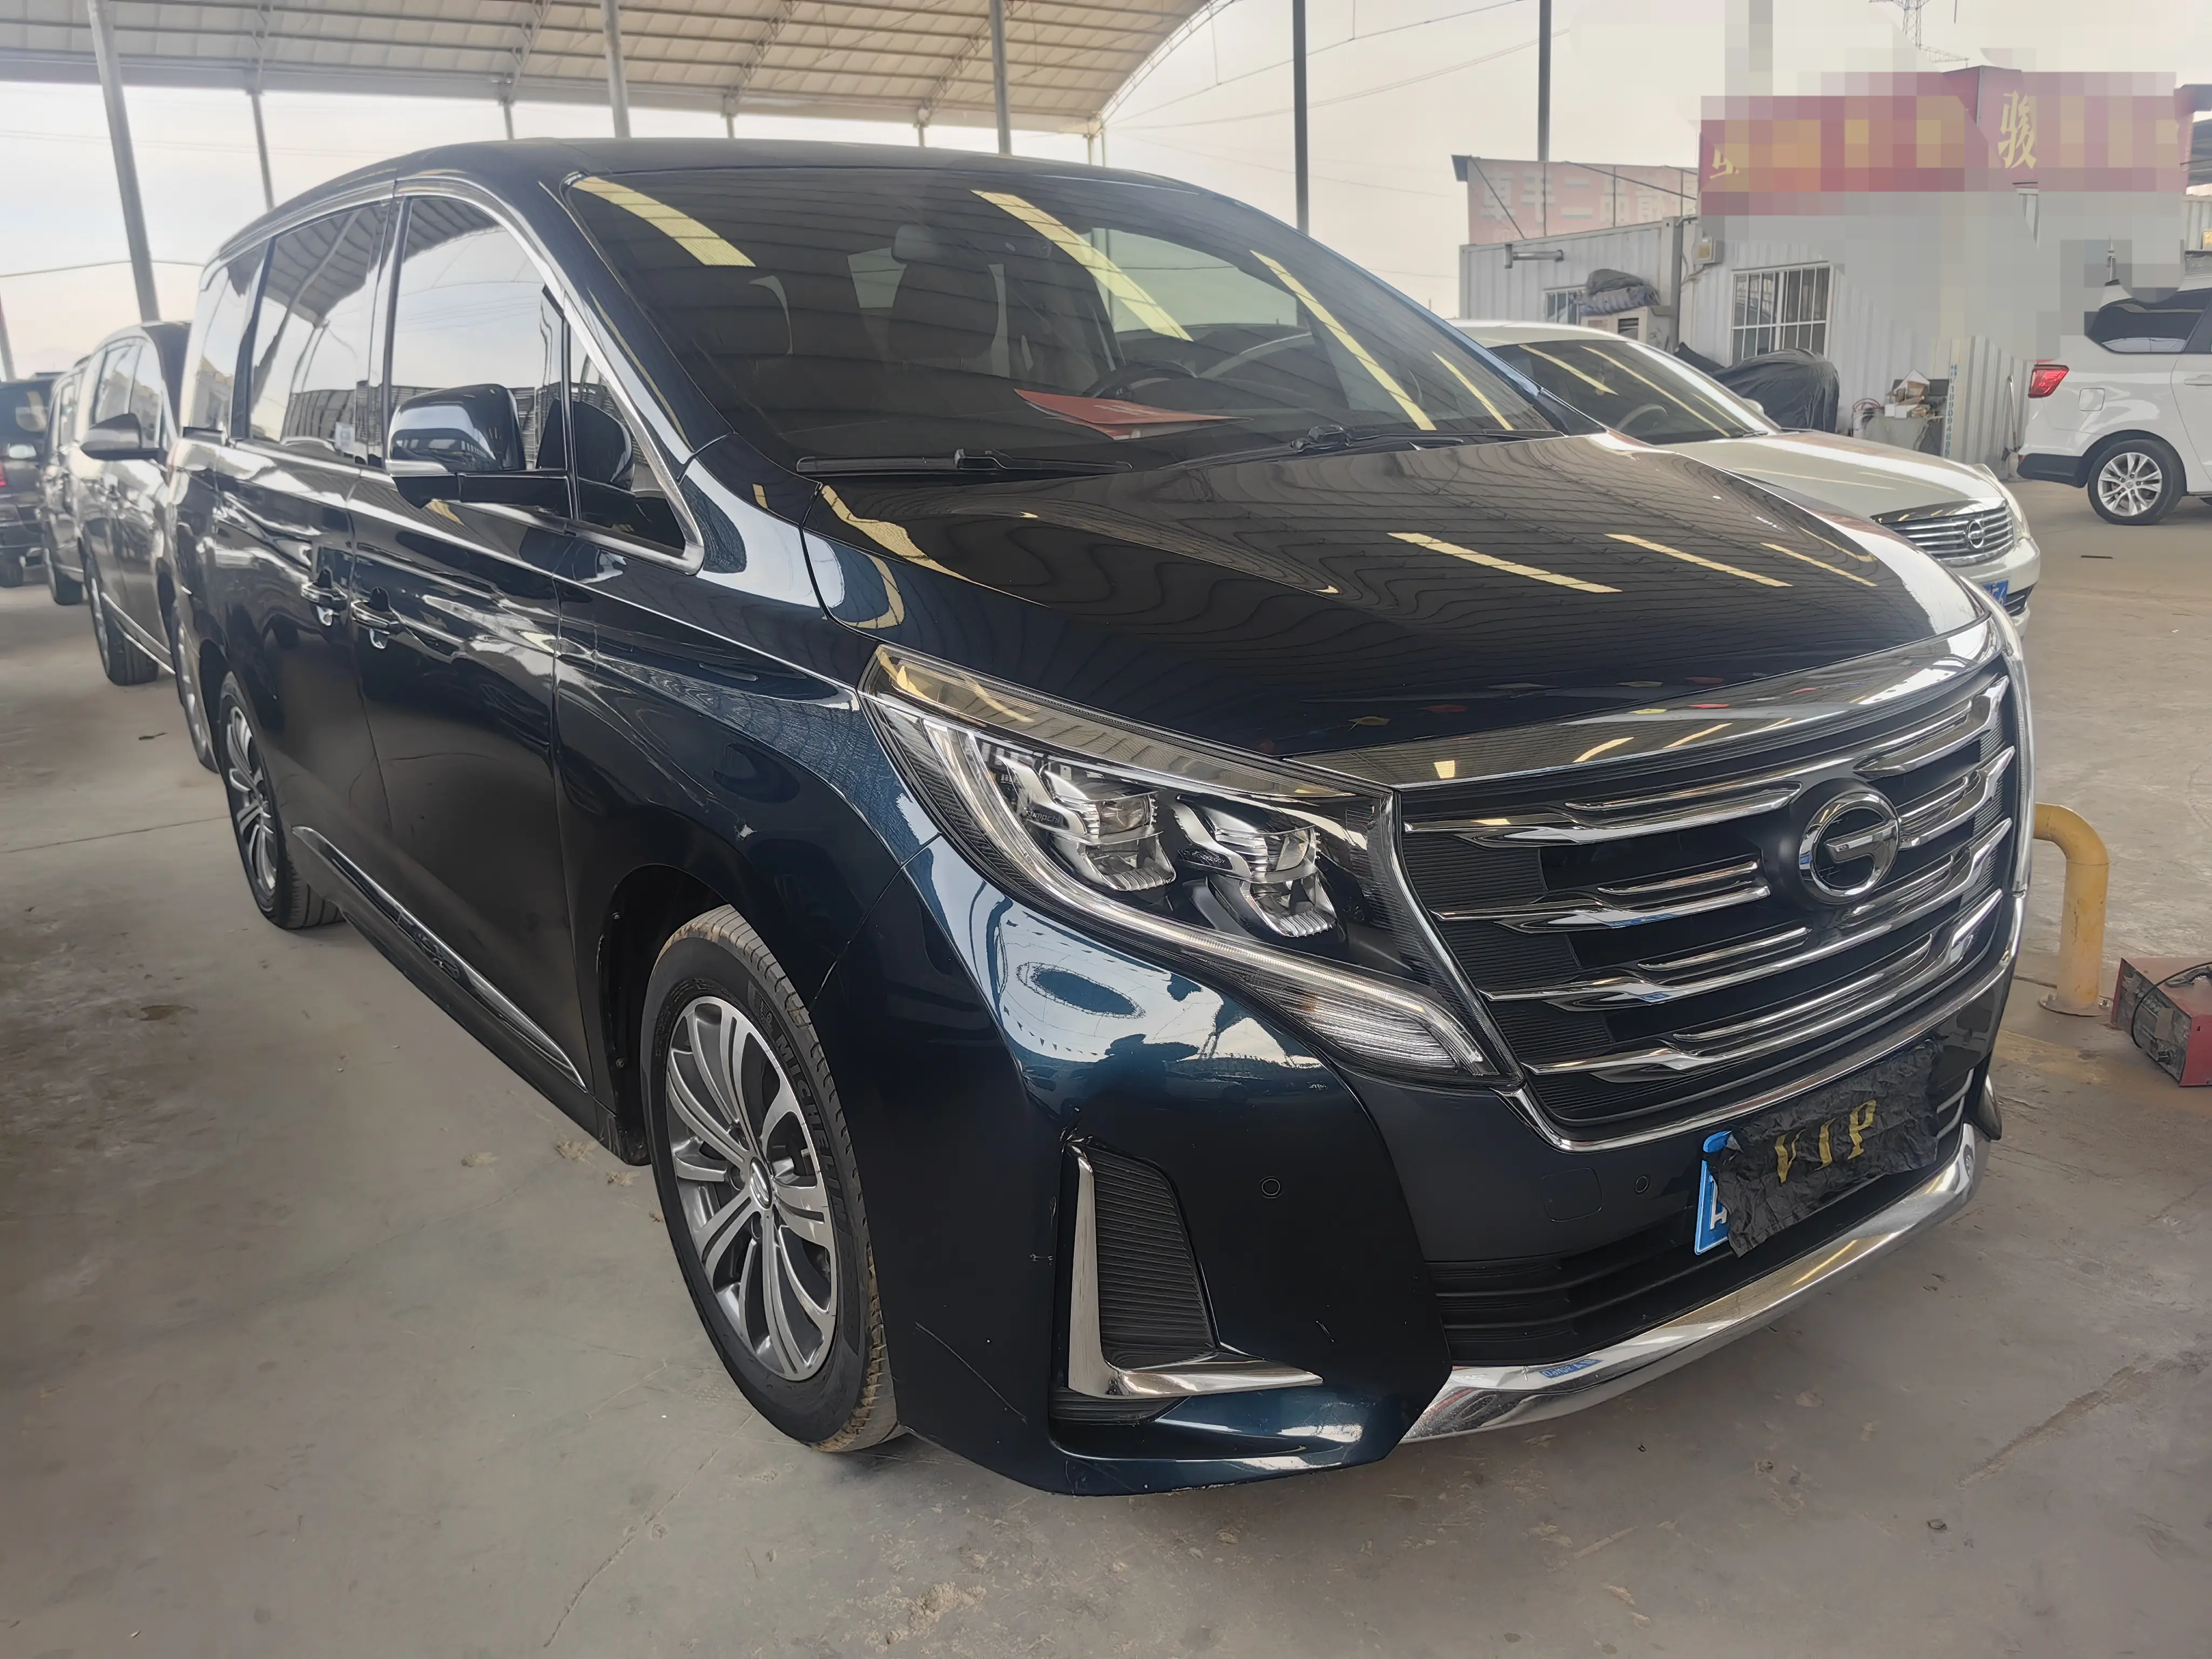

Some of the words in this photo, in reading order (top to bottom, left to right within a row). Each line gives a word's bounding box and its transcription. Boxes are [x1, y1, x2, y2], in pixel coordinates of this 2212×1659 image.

[1024, 809, 1061, 824] rumpchi
[775, 1034, 847, 1230] MICHELIN
[1773, 1099, 1878, 1184] VIP
